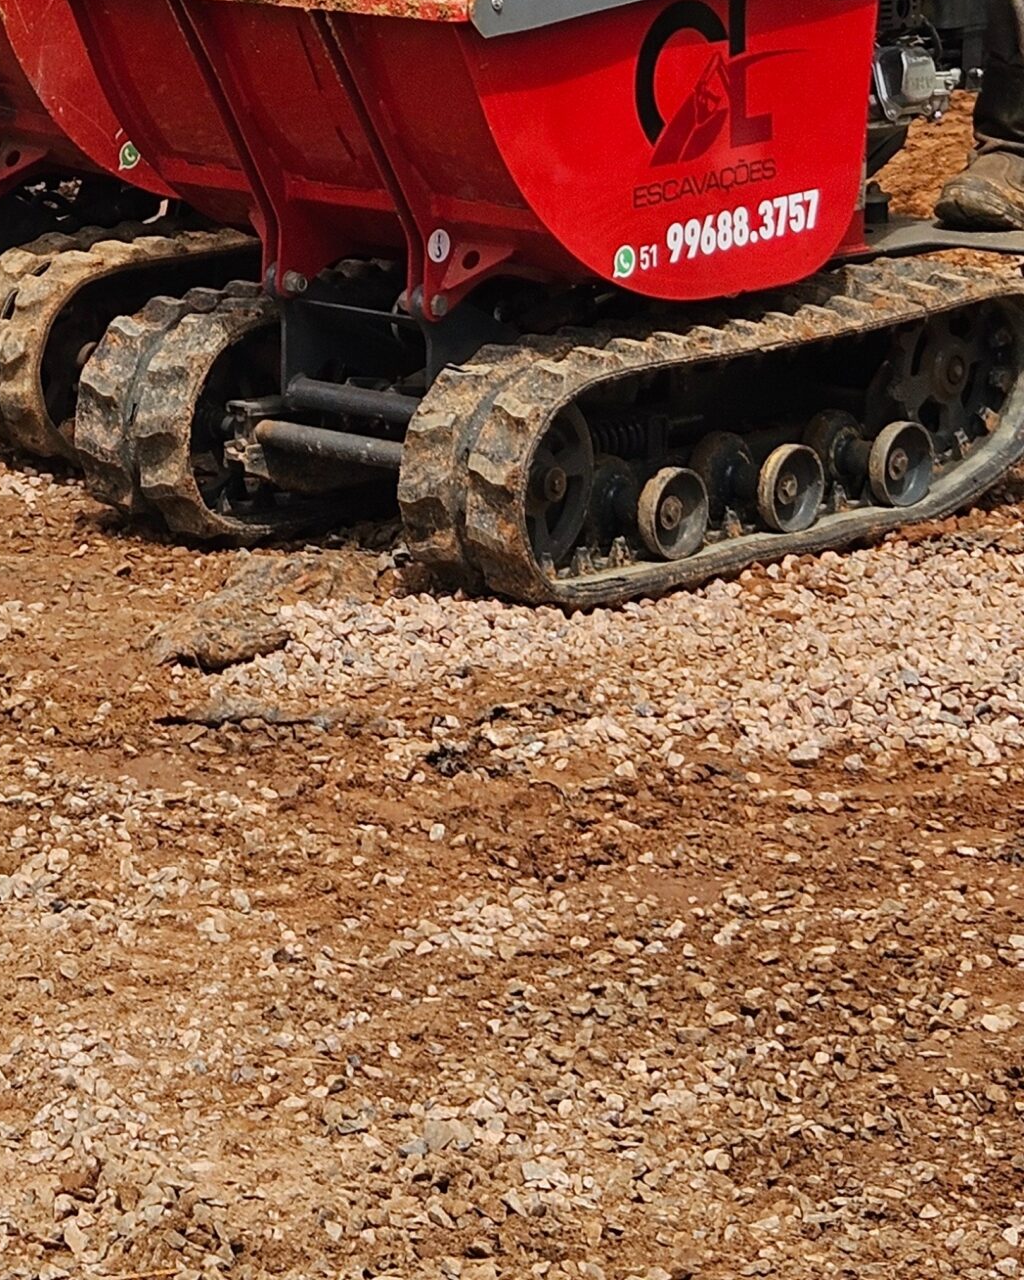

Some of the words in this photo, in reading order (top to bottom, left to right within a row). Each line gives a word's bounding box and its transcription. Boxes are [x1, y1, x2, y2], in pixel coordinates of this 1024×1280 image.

[632, 157, 777, 209] ESCAVAÇÕES
[639, 244, 659, 271] 51
[666, 188, 820, 264] 99688.3757
